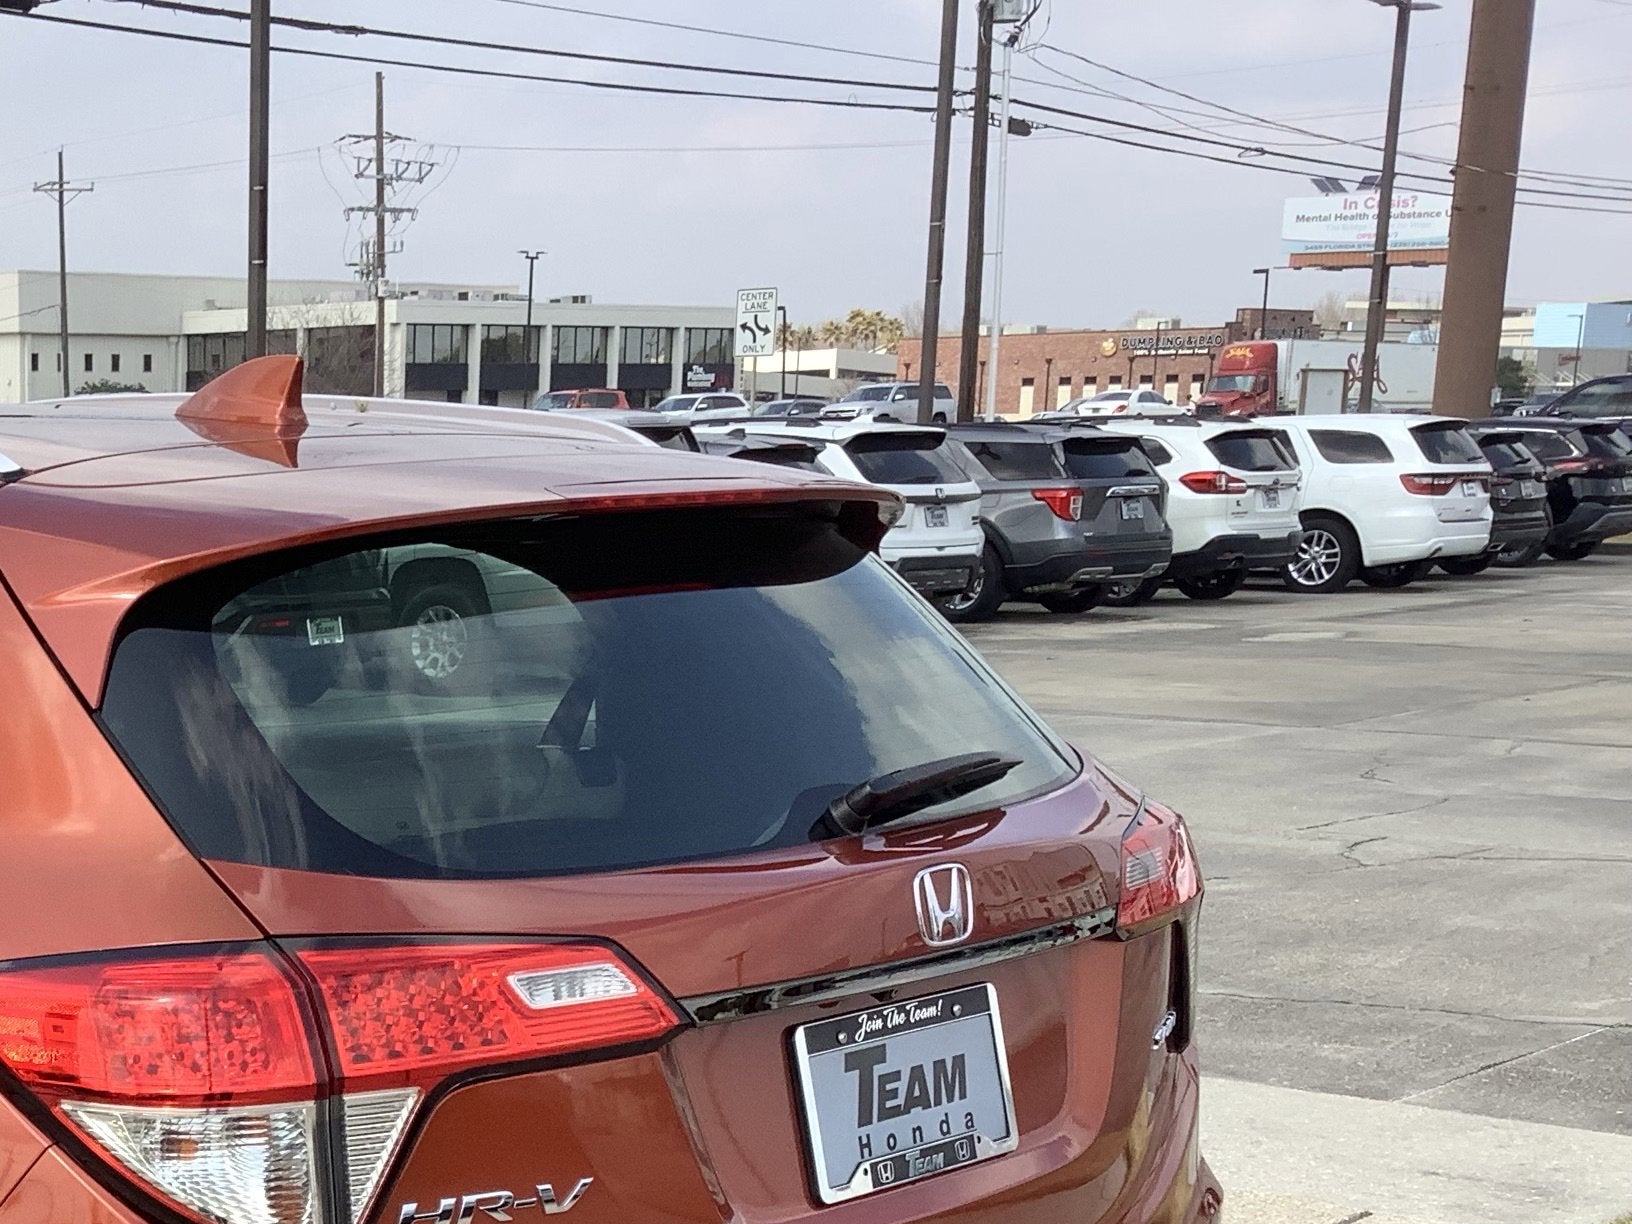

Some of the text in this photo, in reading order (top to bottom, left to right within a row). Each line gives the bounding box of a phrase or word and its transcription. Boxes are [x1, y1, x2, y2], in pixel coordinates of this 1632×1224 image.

[1343, 197, 1358, 210] In
[1295, 213, 1332, 223] Mental
[1335, 212, 1369, 222] Health
[740, 292, 774, 301] CENTER
[745, 301, 768, 310] LANE
[1186, 334, 1197, 346] &
[1198, 334, 1223, 346] BAO
[742, 344, 766, 353] ONLY
[855, 999, 943, 1042] Join The Team!
[844, 1043, 967, 1129] TEAM
[858, 1111, 976, 1160] Honda
[905, 1150, 945, 1177] TEAM
